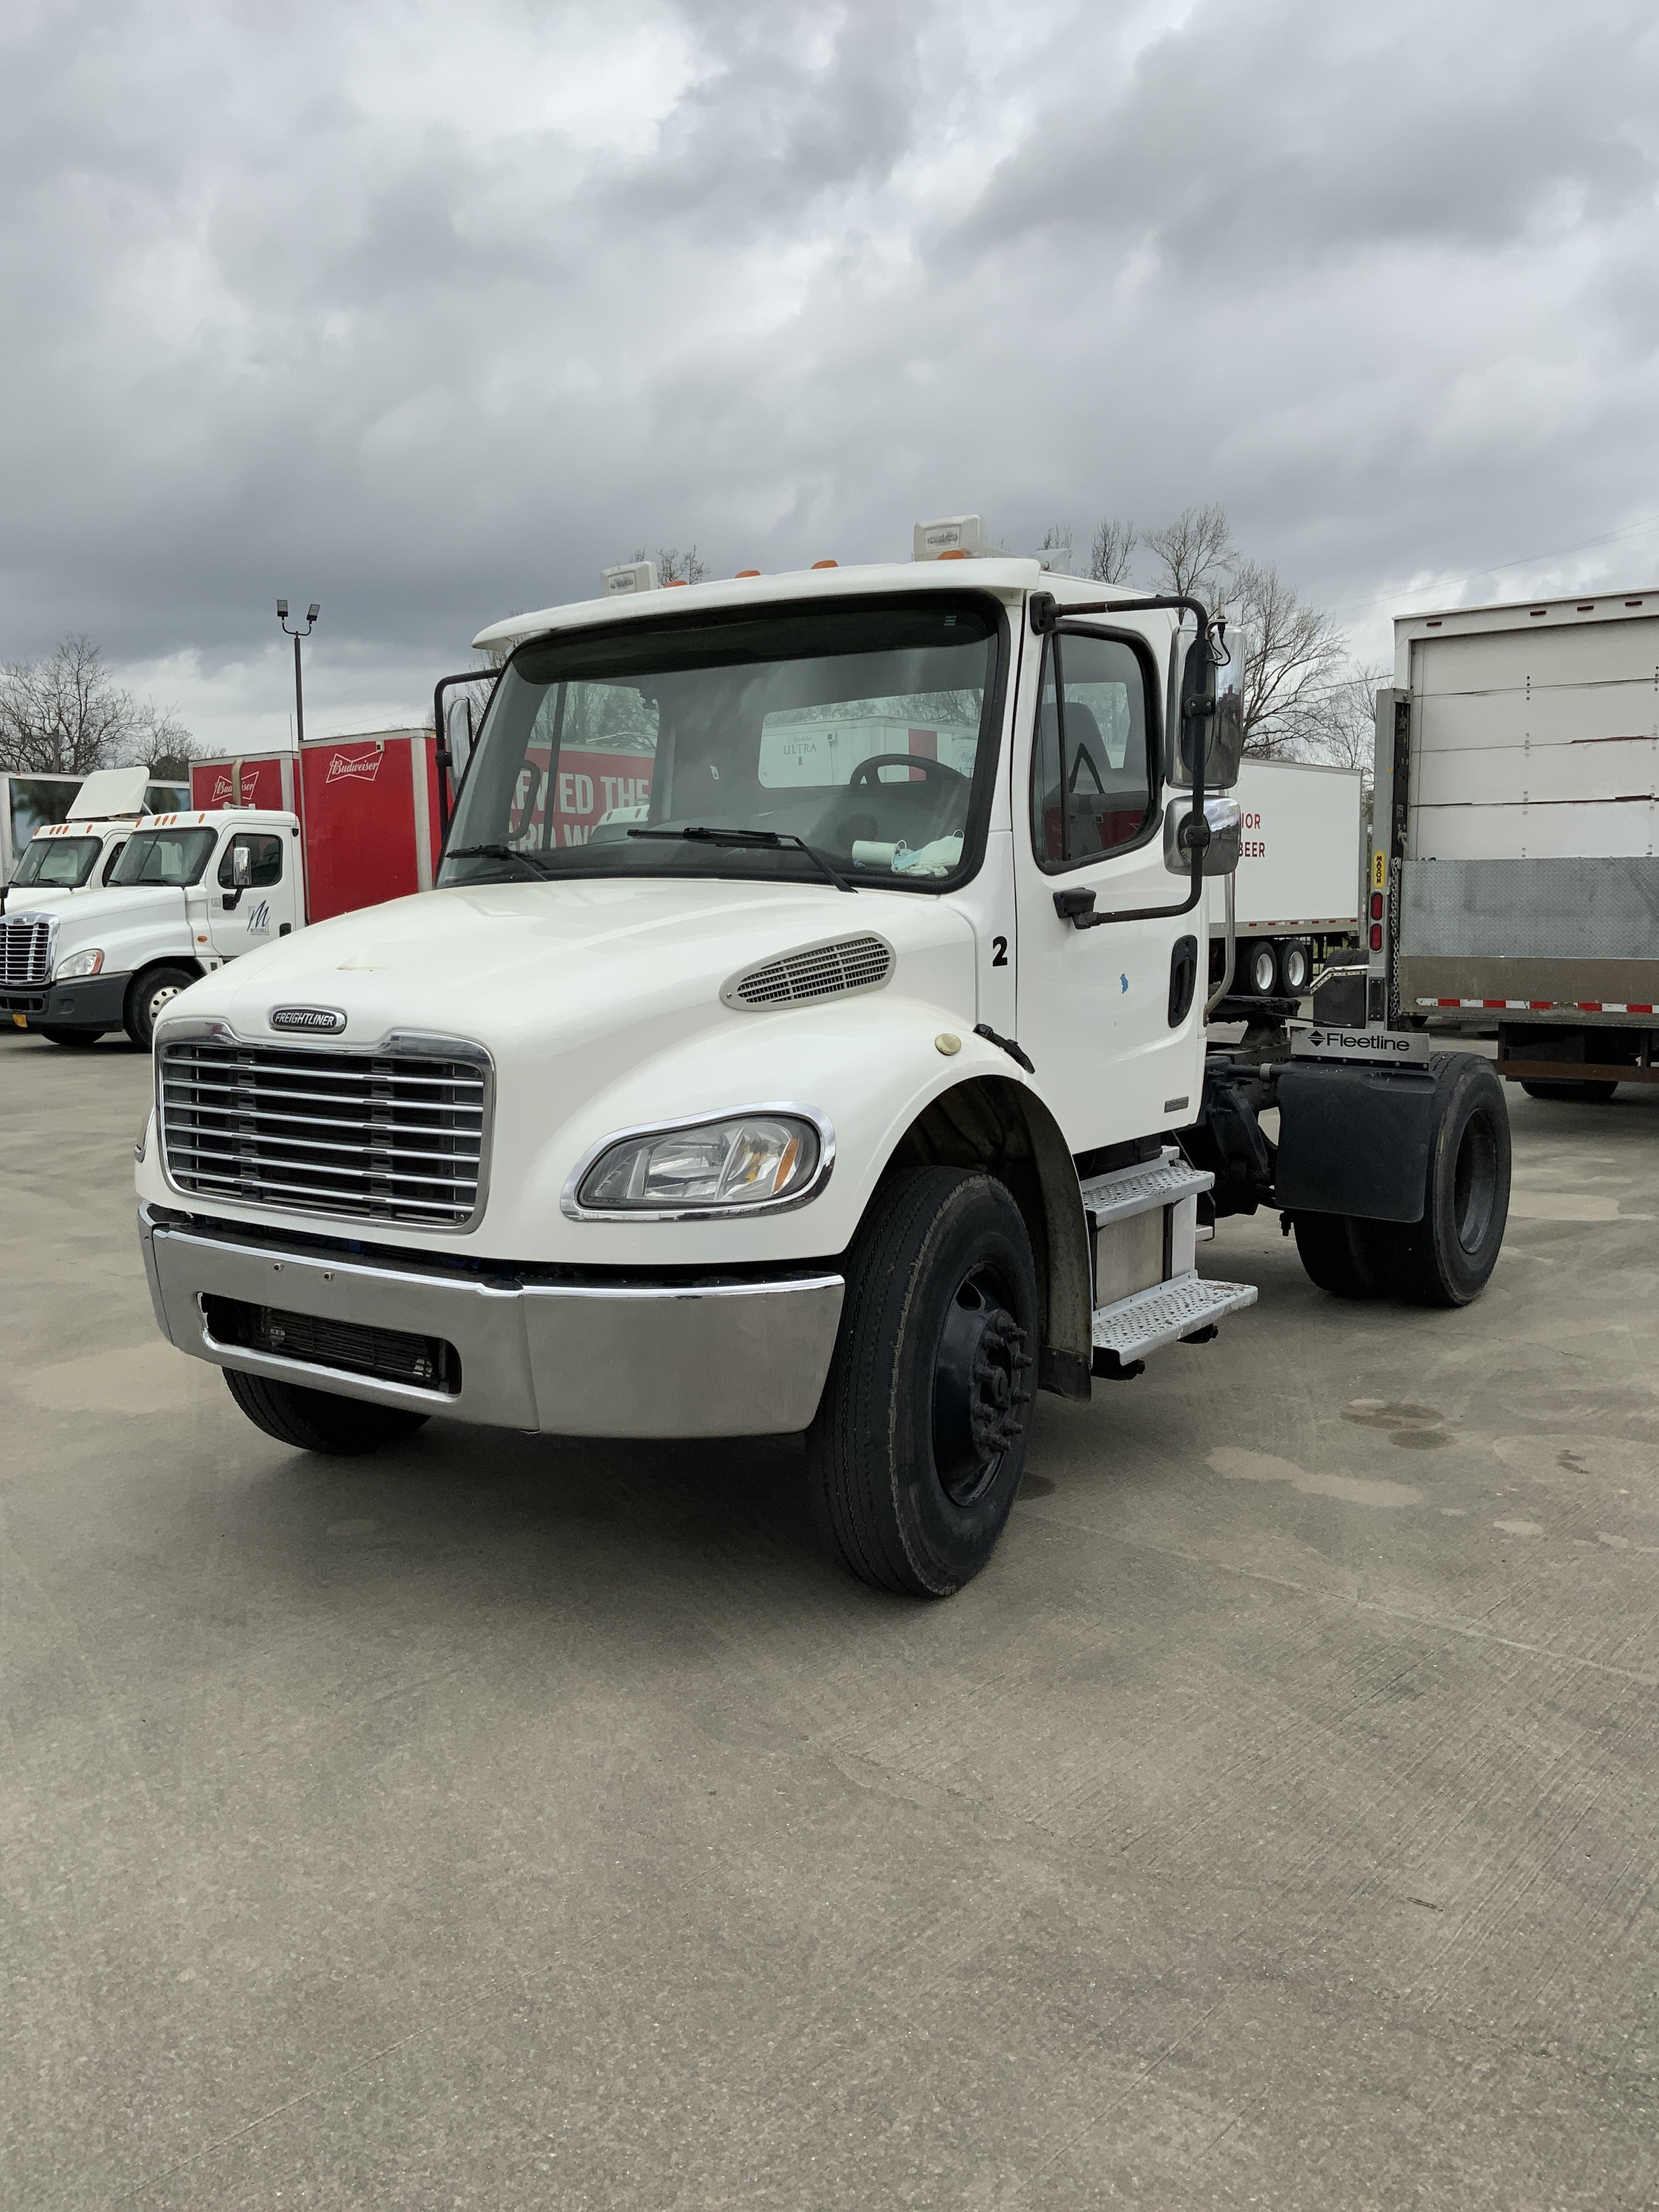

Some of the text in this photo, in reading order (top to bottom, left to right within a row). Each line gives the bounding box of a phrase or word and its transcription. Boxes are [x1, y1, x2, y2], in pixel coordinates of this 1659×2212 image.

[783, 743, 817, 755] ULTRA
[330, 759, 379, 775] Budweiser
[1238, 842, 1265, 857] BEER
[992, 935, 1008, 967] 2
[275, 1012, 335, 1026] FREIGHTLINER
[1327, 1032, 1410, 1052] Fleetline
